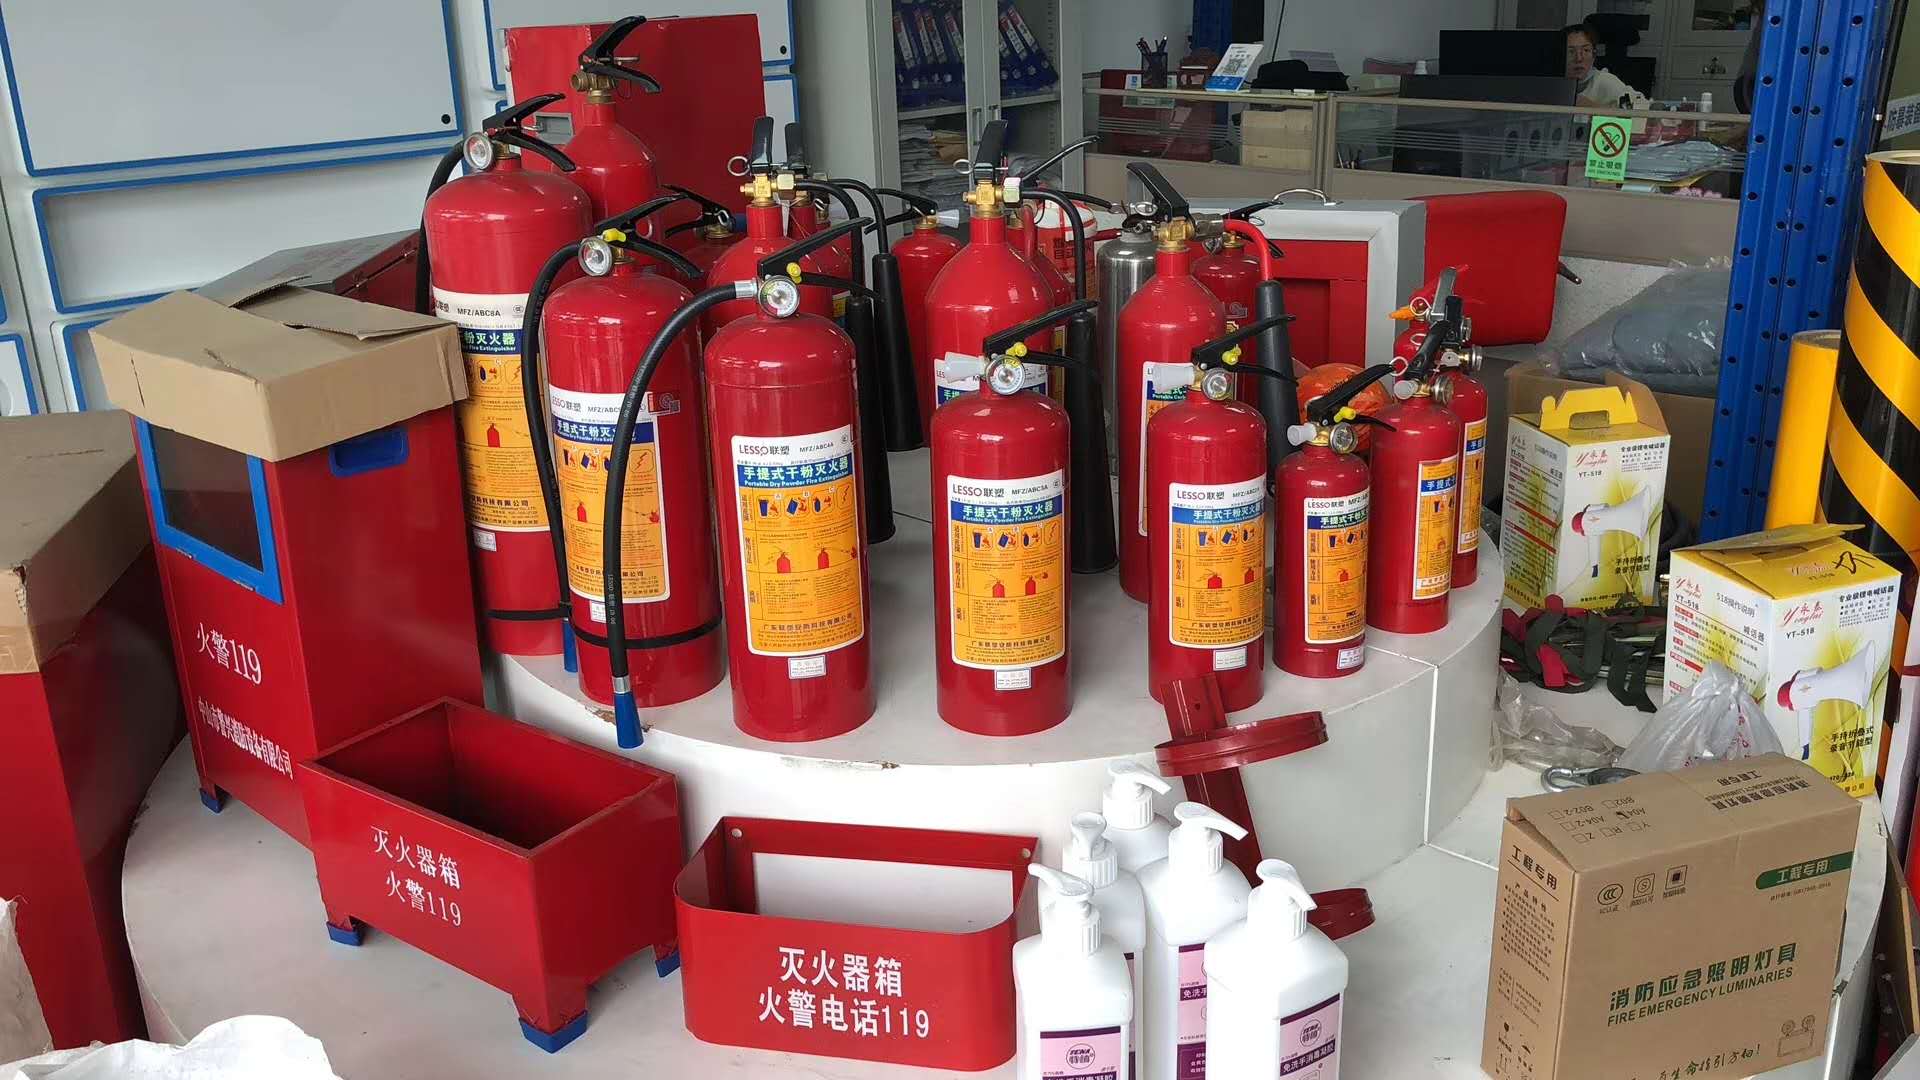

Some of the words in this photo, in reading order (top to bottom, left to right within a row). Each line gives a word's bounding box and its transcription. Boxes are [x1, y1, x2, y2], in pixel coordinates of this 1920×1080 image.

[744, 456, 848, 480] 手提式干粉灭火器
[963, 500, 1053, 519] 手提式干粉灭火器
[1840, 585, 1895, 603] 专业级锂电喊话器
[196, 622, 262, 685] 火警119
[1743, 625, 1765, 642] 喊话器
[1786, 627, 1815, 639] YT-518
[371, 824, 461, 889] 灭火器箱
[1511, 844, 1557, 890] 工程专用
[1776, 859, 1828, 883] 工程专用
[386, 869, 462, 927] 火警119
[778, 946, 903, 998] 灭火器箱
[1609, 942, 1797, 1012] 消防应急照明灯具
[758, 986, 930, 1039] 火警电话119
[1607, 1009, 1636, 1027] FIRE
[1638, 987, 1717, 1018] EMERGENCY
[1719, 967, 1793, 996] LUMINARIES
